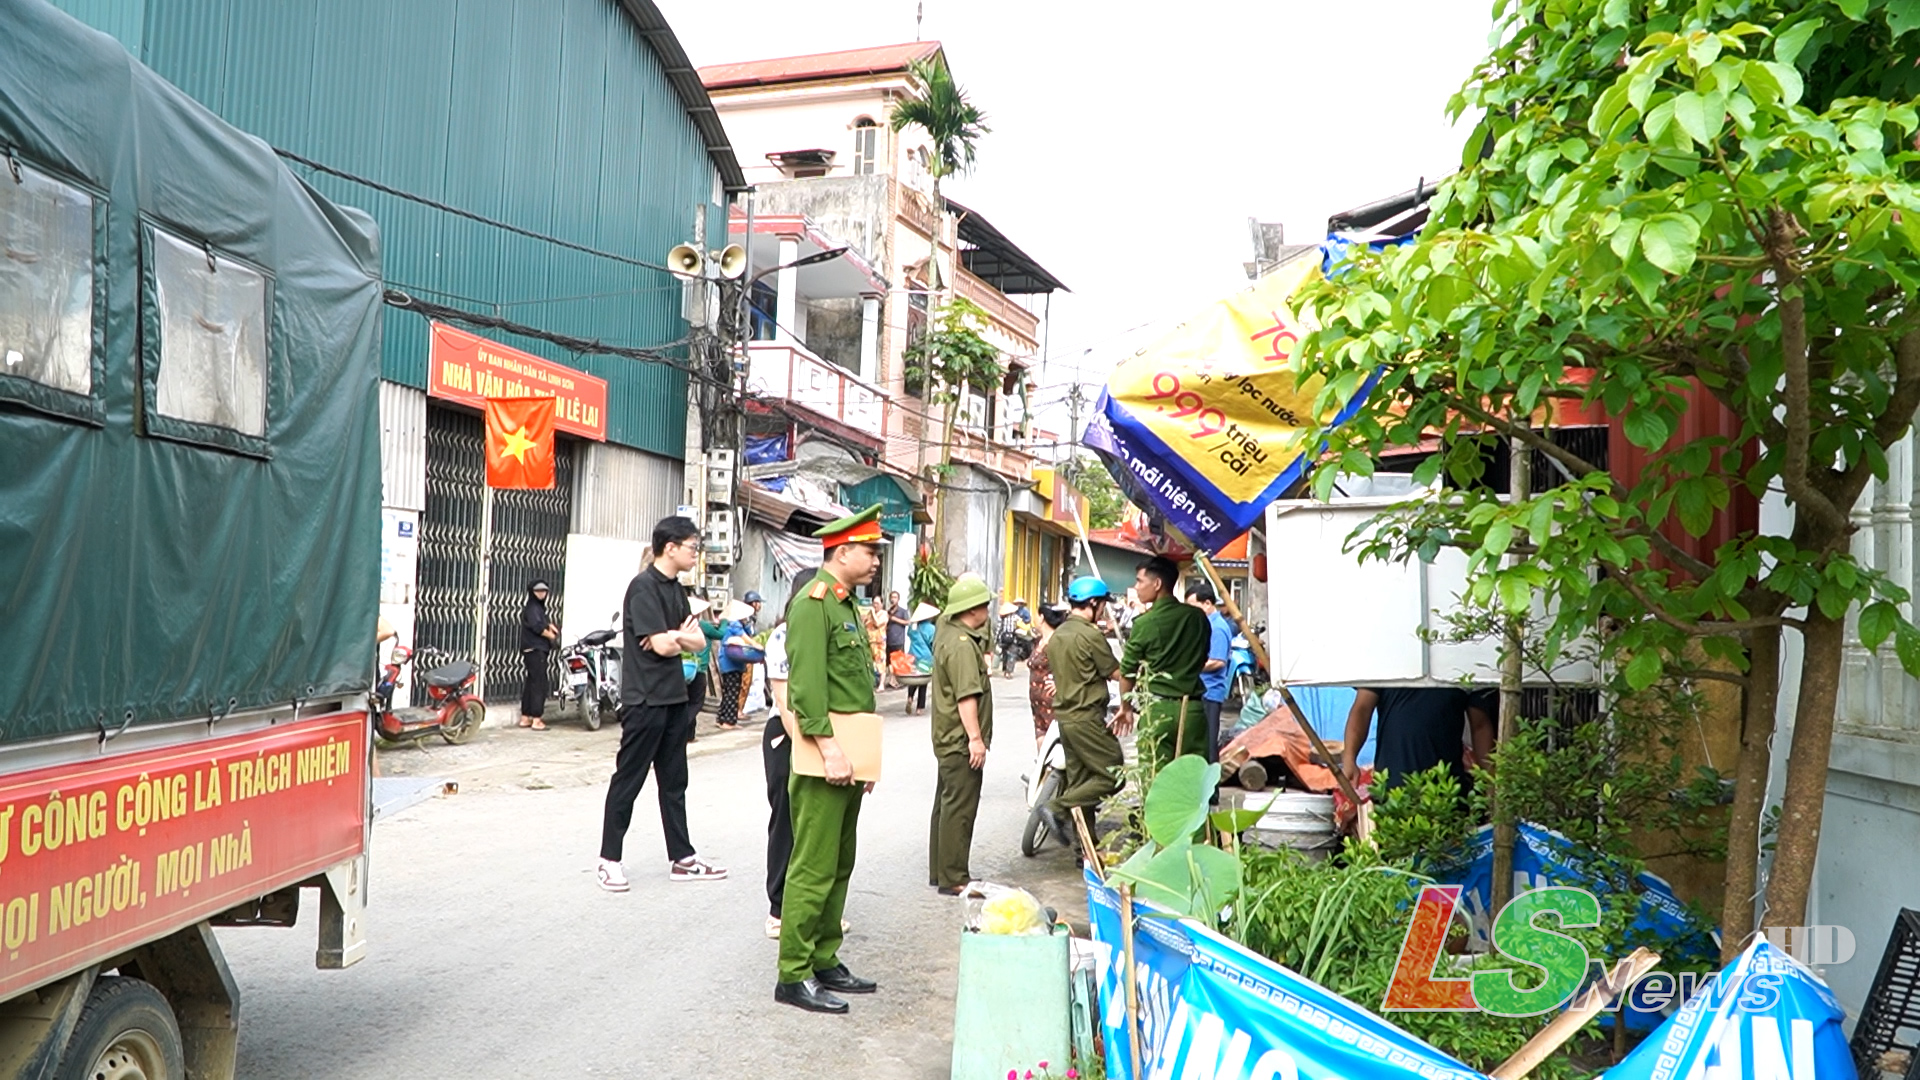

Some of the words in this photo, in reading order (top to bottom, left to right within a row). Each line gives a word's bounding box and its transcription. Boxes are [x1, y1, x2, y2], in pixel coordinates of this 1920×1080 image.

[443, 361, 473, 392] NHÀ
[476, 370, 504, 398] VĂN
[567, 397, 580, 423] LÊ
[582, 404, 599, 428] LAI
[488, 354, 503, 368] BAN
[548, 374, 562, 387] LINH
[1237, 377, 1262, 400] lọc
[1261, 397, 1300, 427] nước
[1226, 423, 1268, 464] triệu
[1130, 457, 1164, 488] mãi
[1159, 479, 1196, 515] hiện
[1195, 510, 1221, 533] tại
[21, 789, 107, 857] CÔNG
[116, 772, 187, 837] CỘNG
[194, 758, 222, 813] LÀ
[228, 749, 292, 803] TRÁCH
[296, 737, 350, 786] NHIỆM
[0, 892, 39, 962] ỌI
[49, 854, 147, 936] NGƯỜI,
[155, 841, 203, 898] MỌI
